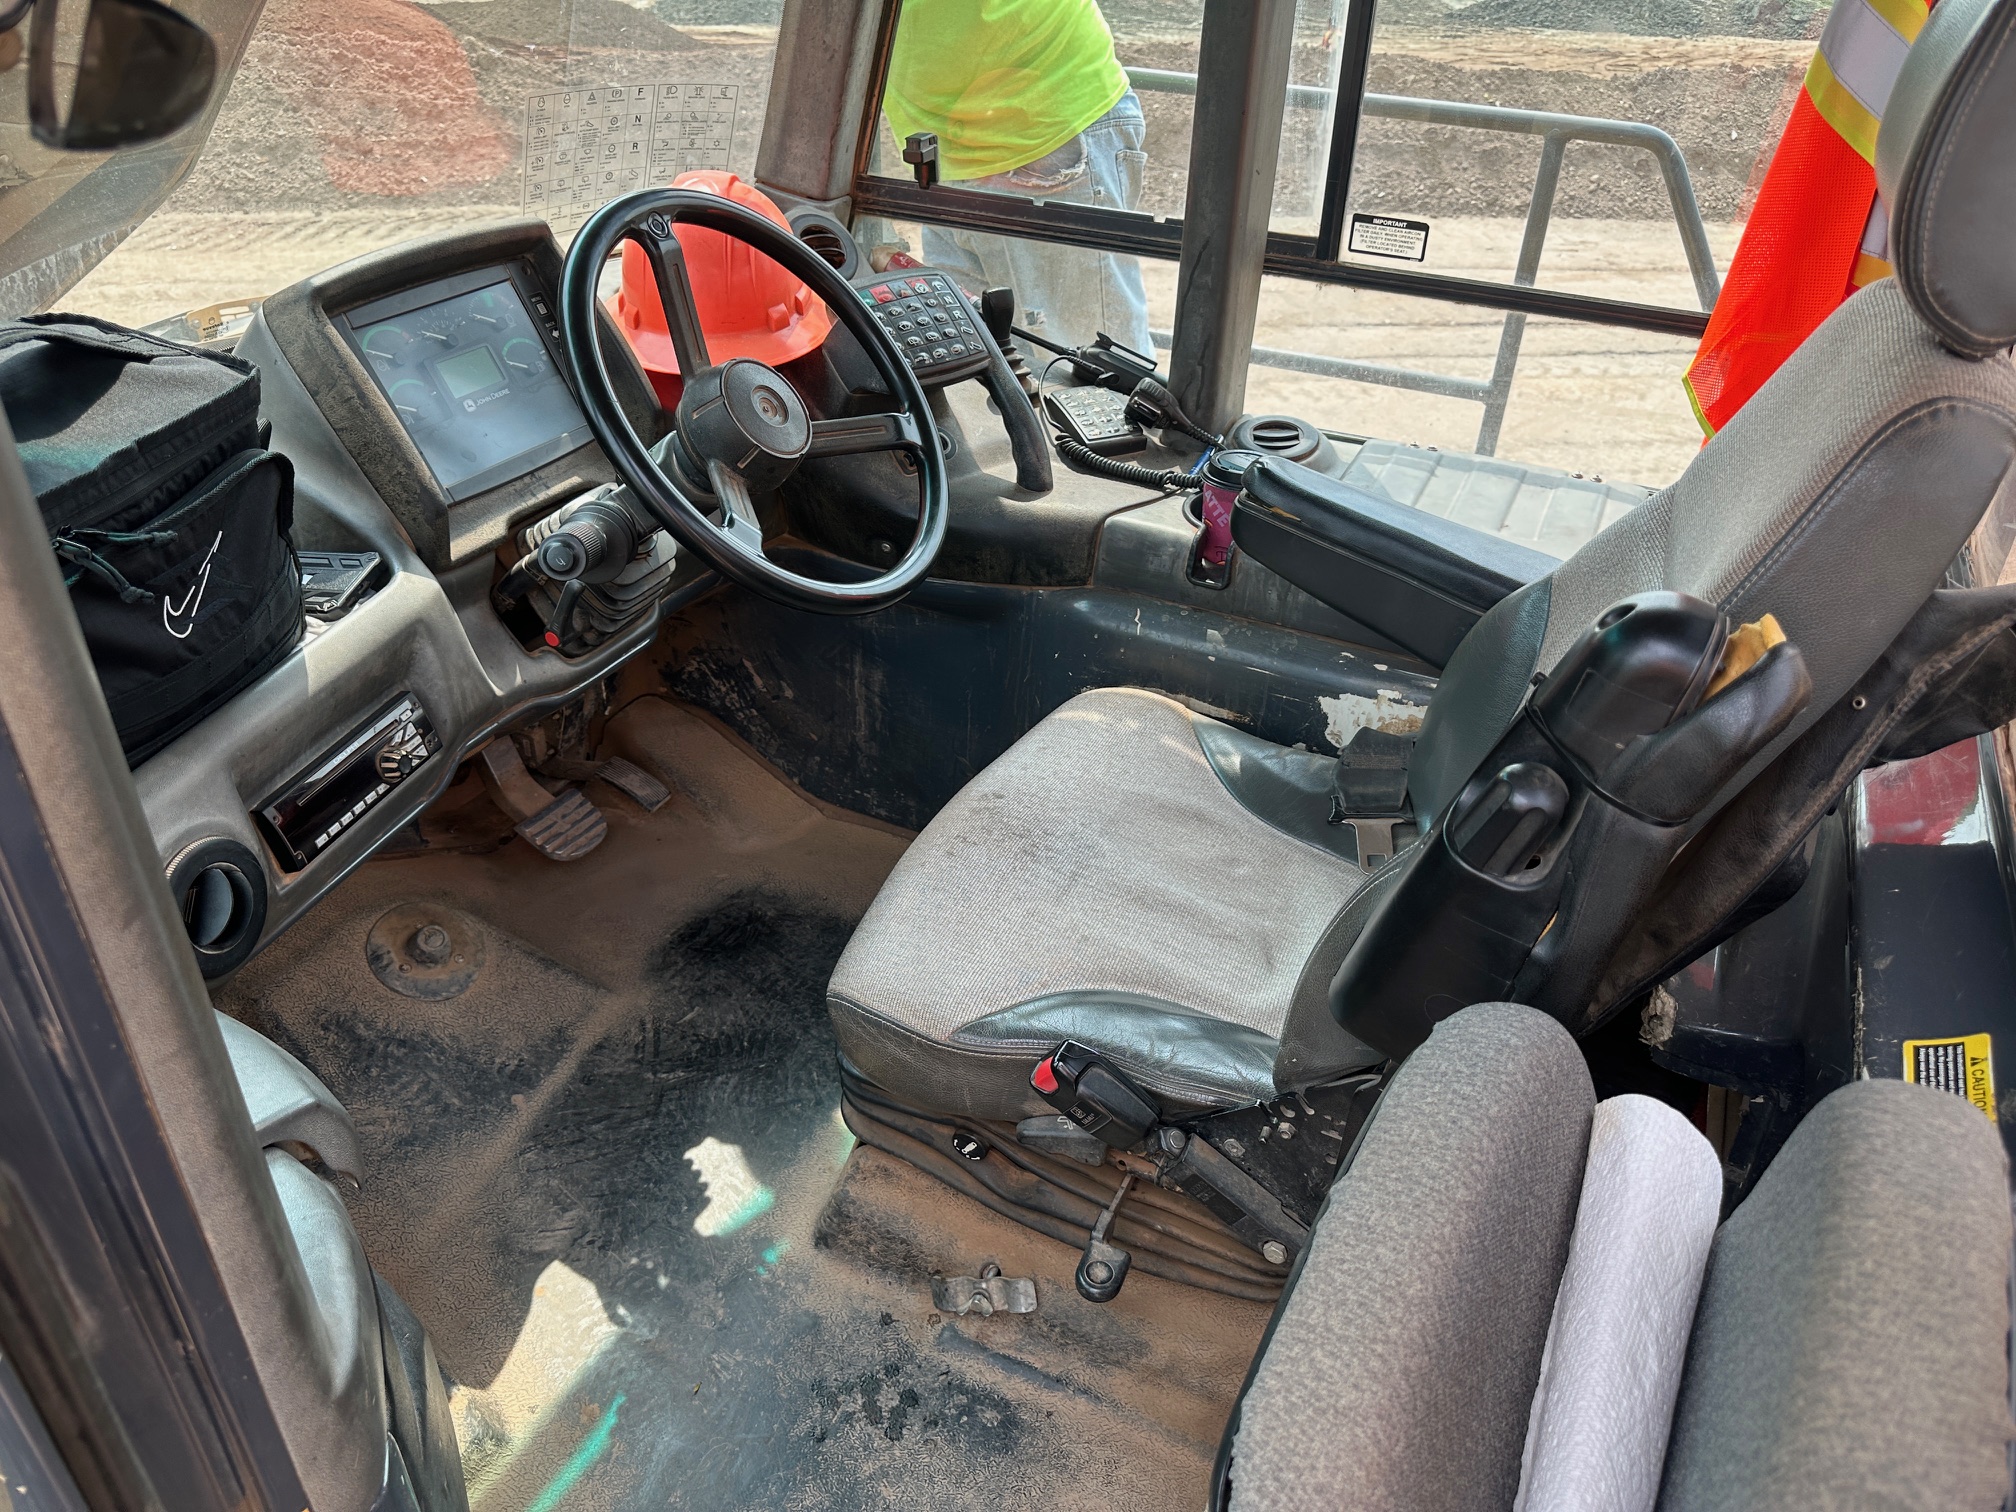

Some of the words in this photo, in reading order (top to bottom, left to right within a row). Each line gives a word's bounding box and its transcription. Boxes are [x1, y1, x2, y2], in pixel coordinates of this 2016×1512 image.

[637, 87, 644, 96] F
[634, 114, 642, 123] N
[632, 142, 639, 150] R
[1372, 218, 1407, 228] IMPORTANT
[952, 310, 963, 319] R
[476, 395, 492, 406] JOHN
[490, 388, 511, 400] DEERE
[1204, 489, 1230, 528] ATTE
